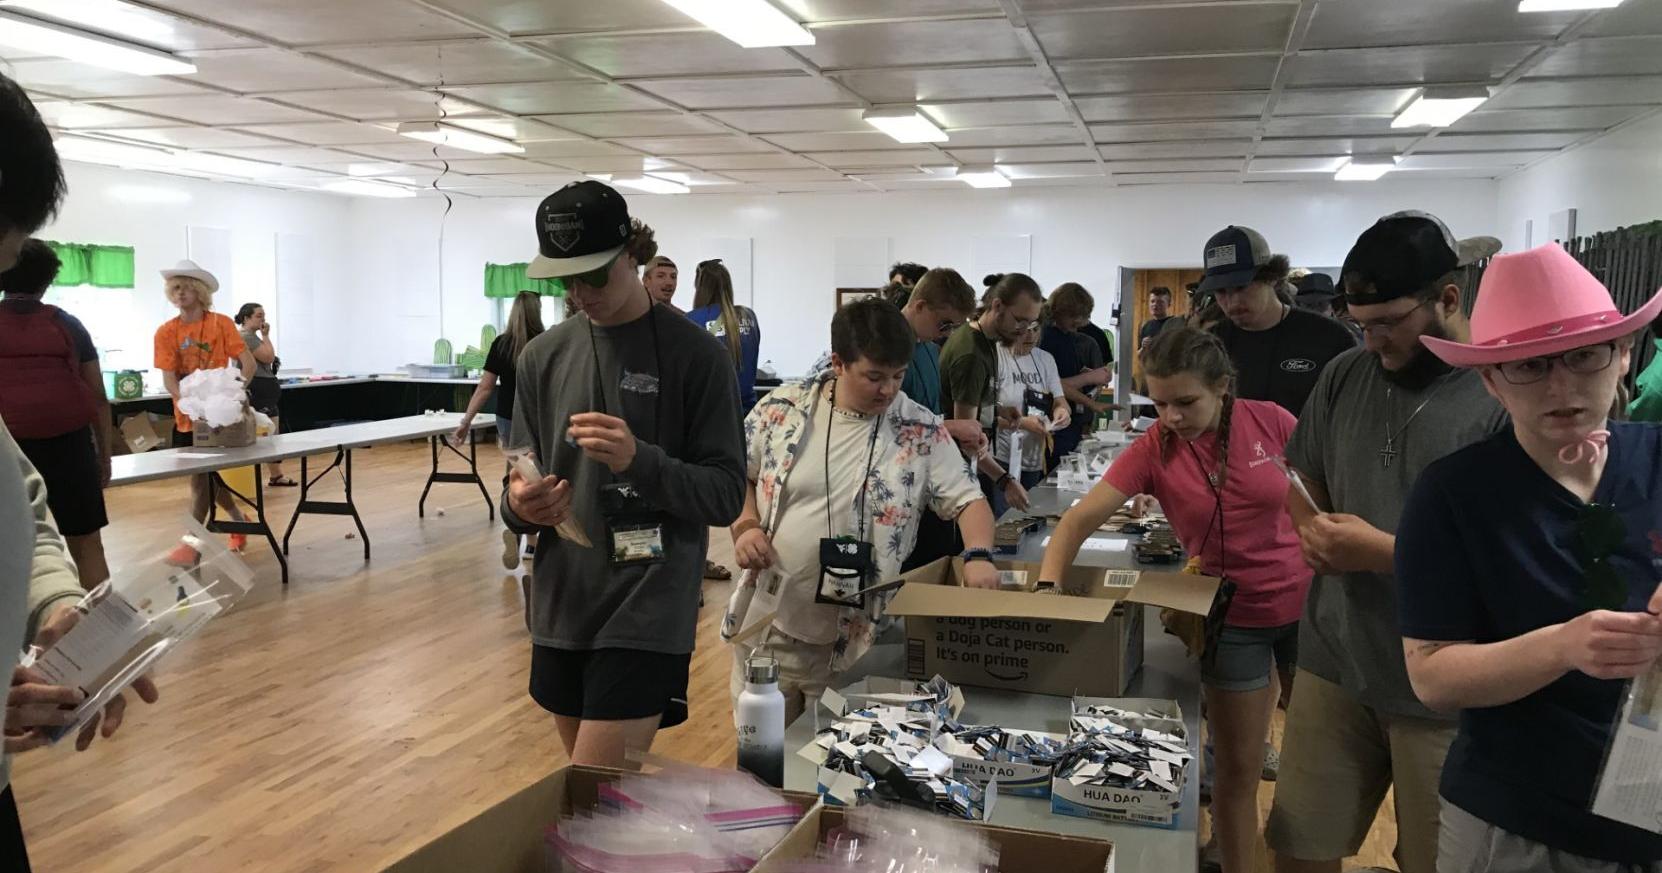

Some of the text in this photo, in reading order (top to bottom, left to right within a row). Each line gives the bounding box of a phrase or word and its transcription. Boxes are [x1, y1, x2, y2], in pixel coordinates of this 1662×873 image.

[1285, 360, 1310, 371] Ford
[1012, 371, 1042, 384] MOOD
[981, 617, 1031, 632] person
[1035, 622, 1052, 633] or
[936, 630, 1070, 654] a Doja Cat person.
[936, 647, 1029, 668] It's on prime
[989, 767, 1015, 777] DAO
[1083, 789, 1111, 802] HUA
[1113, 793, 1141, 803] DAO
